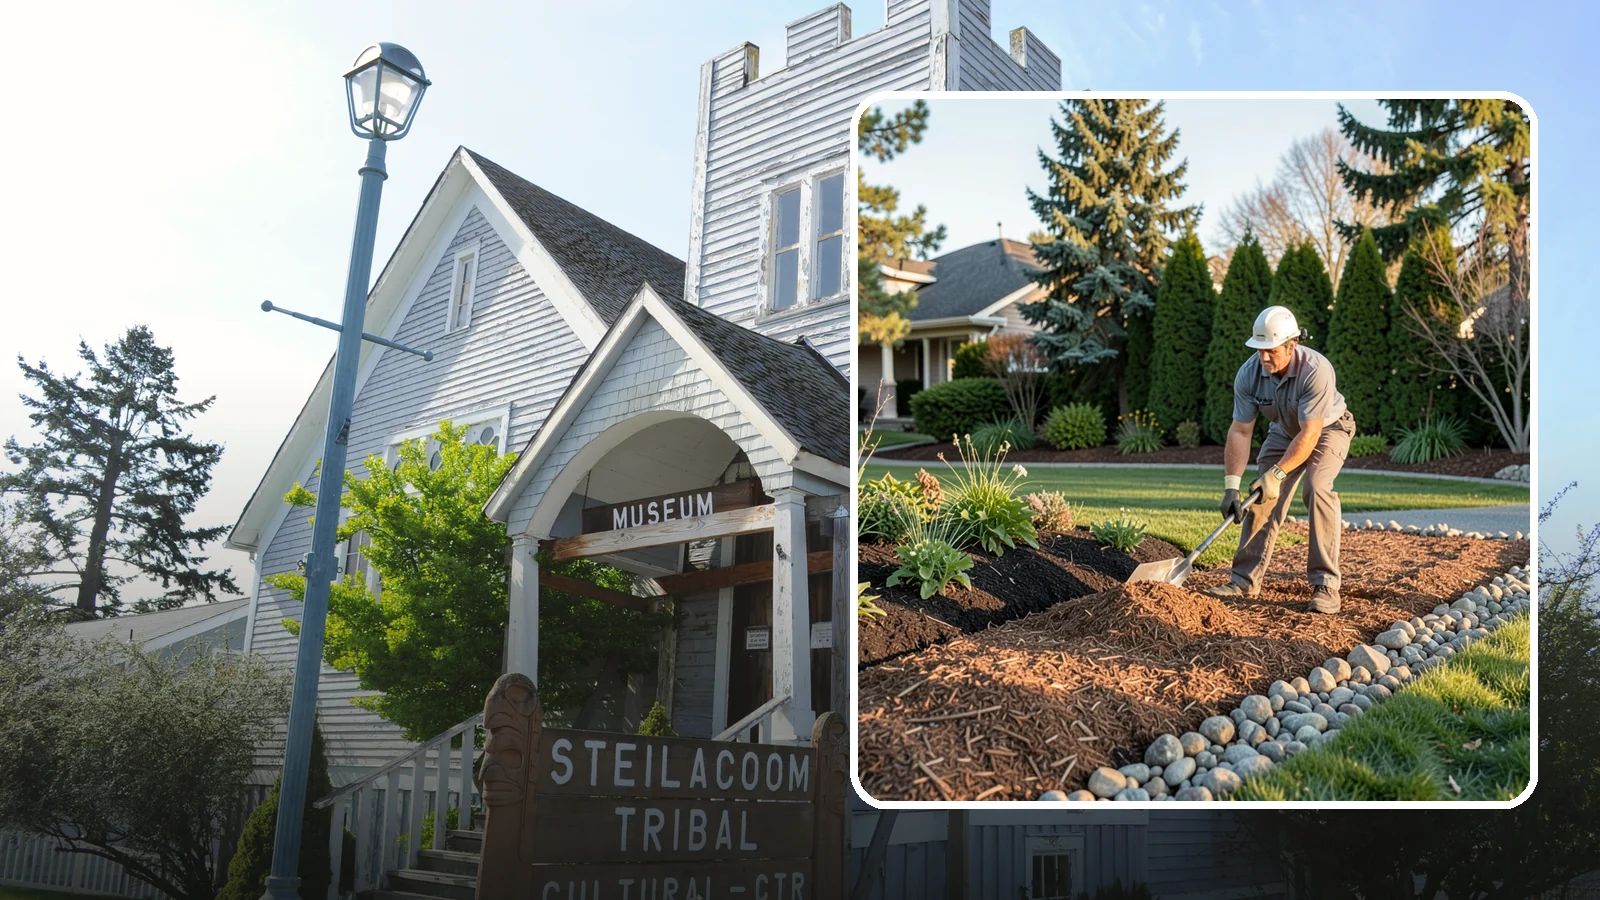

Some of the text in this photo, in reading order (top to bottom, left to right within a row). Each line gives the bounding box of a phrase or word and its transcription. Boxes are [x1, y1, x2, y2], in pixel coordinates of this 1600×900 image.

[612, 491, 714, 531] MUSEUM
[550, 738, 809, 792] STEILACOOM
[614, 806, 757, 851] TRIBAL
